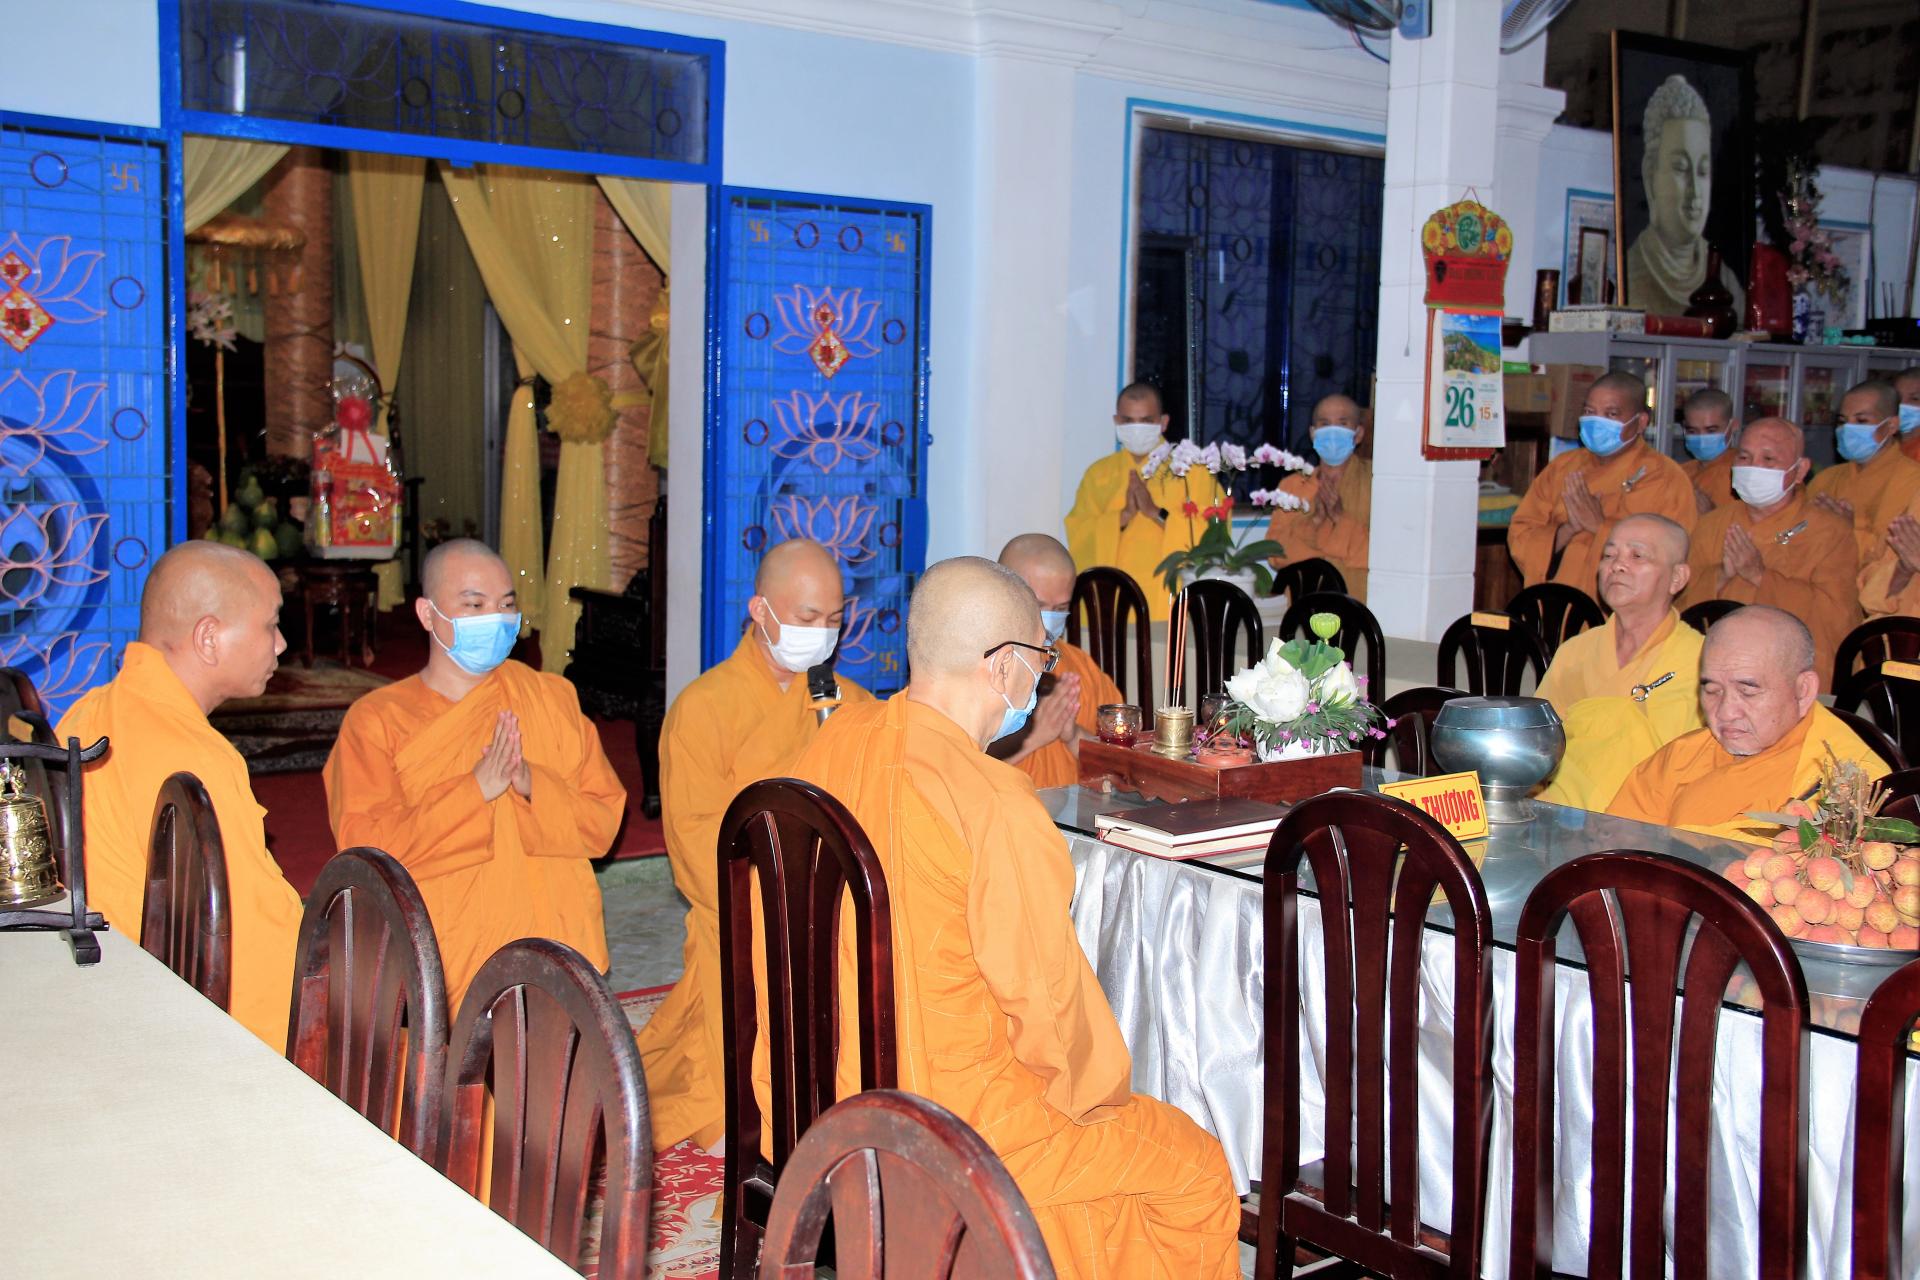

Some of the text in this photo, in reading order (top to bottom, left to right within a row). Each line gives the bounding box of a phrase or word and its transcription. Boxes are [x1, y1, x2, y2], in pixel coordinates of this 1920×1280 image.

[1445, 386, 1474, 428] 26
[1479, 406, 1491, 420] 15
[1422, 789, 1480, 830] THƯỢNG
